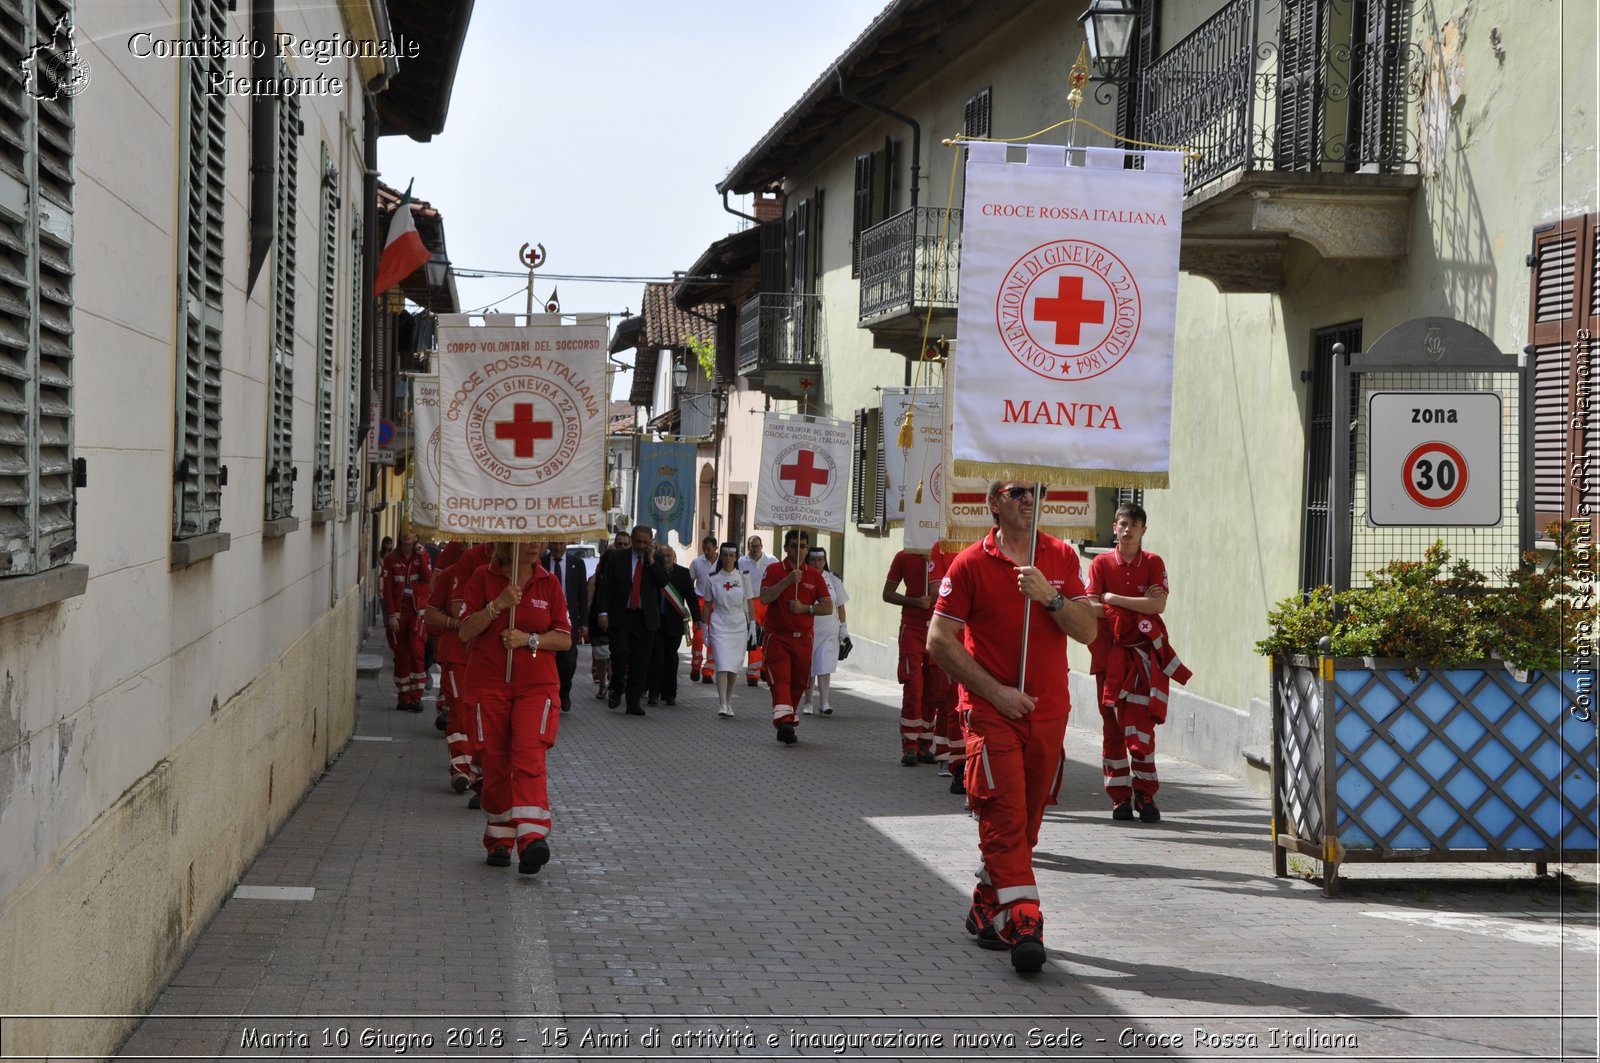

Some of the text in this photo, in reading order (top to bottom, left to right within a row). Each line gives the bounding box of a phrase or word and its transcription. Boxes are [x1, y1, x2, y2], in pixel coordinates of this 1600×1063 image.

[982, 204, 1167, 226] CROCE ROSSA ITALIANA
[1002, 245, 1136, 374] CONVENZIONE DI GINEVRA 22 AGOSTO 1864
[446, 339, 600, 353] CORPO VOLONTARI DEL SOCCORSO
[447, 355, 599, 422] CROCE ROSSA ITALIANA
[485, 389, 500, 403] DI
[503, 378, 559, 400] GINEVRA
[558, 398, 573, 414] 22
[1002, 399, 1122, 430] MANTA
[1411, 407, 1458, 424] zona
[470, 404, 512, 480] CONVENZIONE
[559, 415, 578, 459] AGOSTO
[764, 430, 850, 446] CROCE ROSSA ITALIANA
[1415, 459, 1456, 491] 30
[446, 496, 518, 511] GRUPPO
[525, 497, 541, 511] DI
[547, 494, 600, 510] MELLE
[771, 504, 821, 516] DELEGAZIONE
[447, 513, 528, 530] COMITATO
[537, 513, 597, 529] LOCALE
[772, 512, 828, 525] PEVERAGNO
